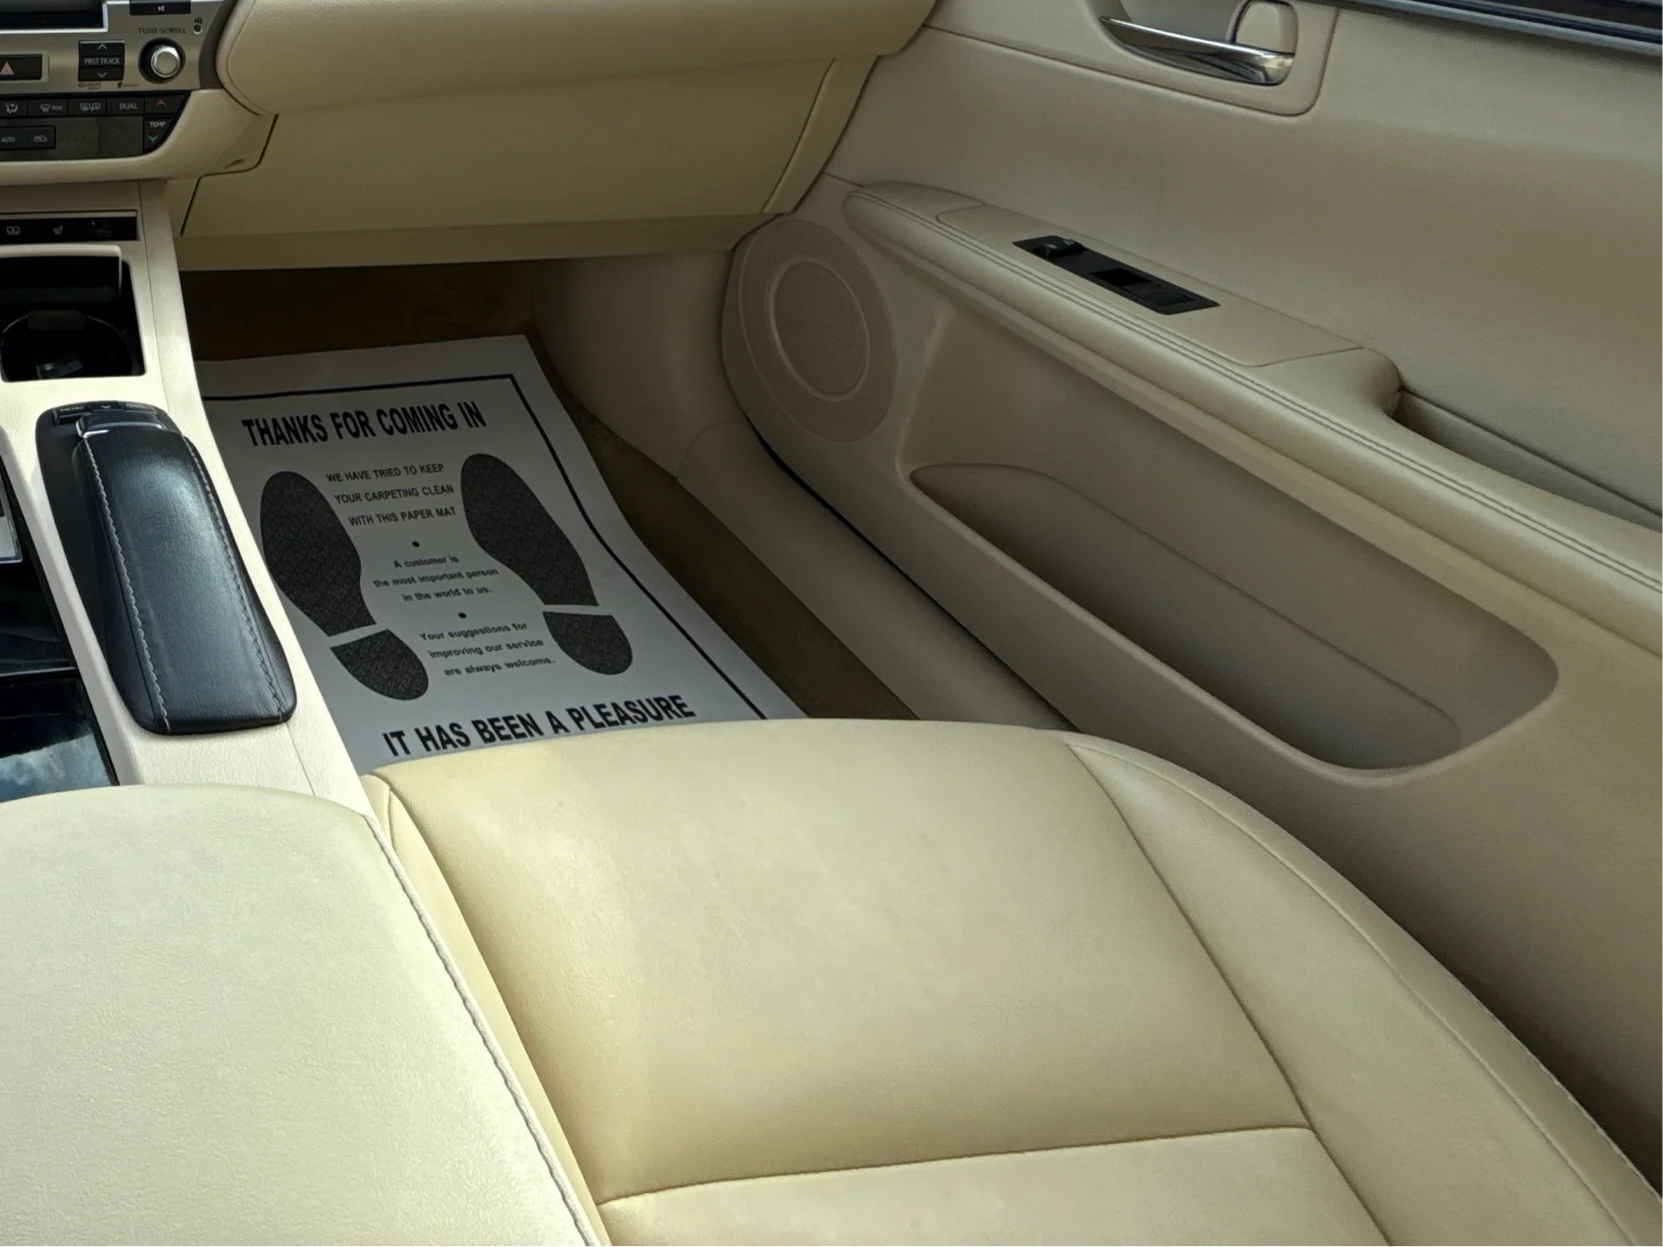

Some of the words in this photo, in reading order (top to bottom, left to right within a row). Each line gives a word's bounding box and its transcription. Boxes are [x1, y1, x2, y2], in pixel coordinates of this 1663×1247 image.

[241, 414, 328, 446] THANKS
[329, 410, 377, 440] FOR
[376, 403, 458, 436] COMING
[457, 401, 487, 428] IN
[326, 473, 342, 483] WE
[345, 471, 372, 481] HAVE
[373, 467, 402, 479] TRIED
[403, 465, 417, 475] TO
[419, 463, 444, 473] KEEP
[334, 493, 362, 504] YOUR
[364, 487, 420, 502] CARPETING
[421, 484, 454, 497] CLEAN
[348, 516, 374, 526] WITH
[376, 512, 399, 524] THIS
[401, 508, 434, 522] PAPER
[436, 506, 457, 518] MAT
[394, 560, 402, 568] A
[404, 556, 447, 568] customer
[449, 555, 459, 564] is
[373, 578, 389, 588] the
[392, 577, 416, 586] most
[418, 571, 464, 583] important
[466, 568, 499, 580] person
[402, 593, 414, 602] in
[415, 591, 432, 601] the
[433, 588, 462, 598] world
[462, 587, 474, 596] to
[476, 587, 493, 595] us.
[419, 631, 444, 641] Your
[447, 625, 511, 639] suggestions
[512, 622, 528, 631] for
[428, 646, 484, 660] improving
[485, 644, 503, 653] our
[505, 638, 544, 650] service
[444, 668, 462, 676] are
[465, 662, 502, 674] always
[503, 657, 556, 669] welcome.
[383, 730, 411, 757] IT
[414, 722, 471, 752] HAS
[471, 712, 544, 744] BEEN
[545, 710, 571, 735] A
[565, 694, 697, 732] PLEASURE
